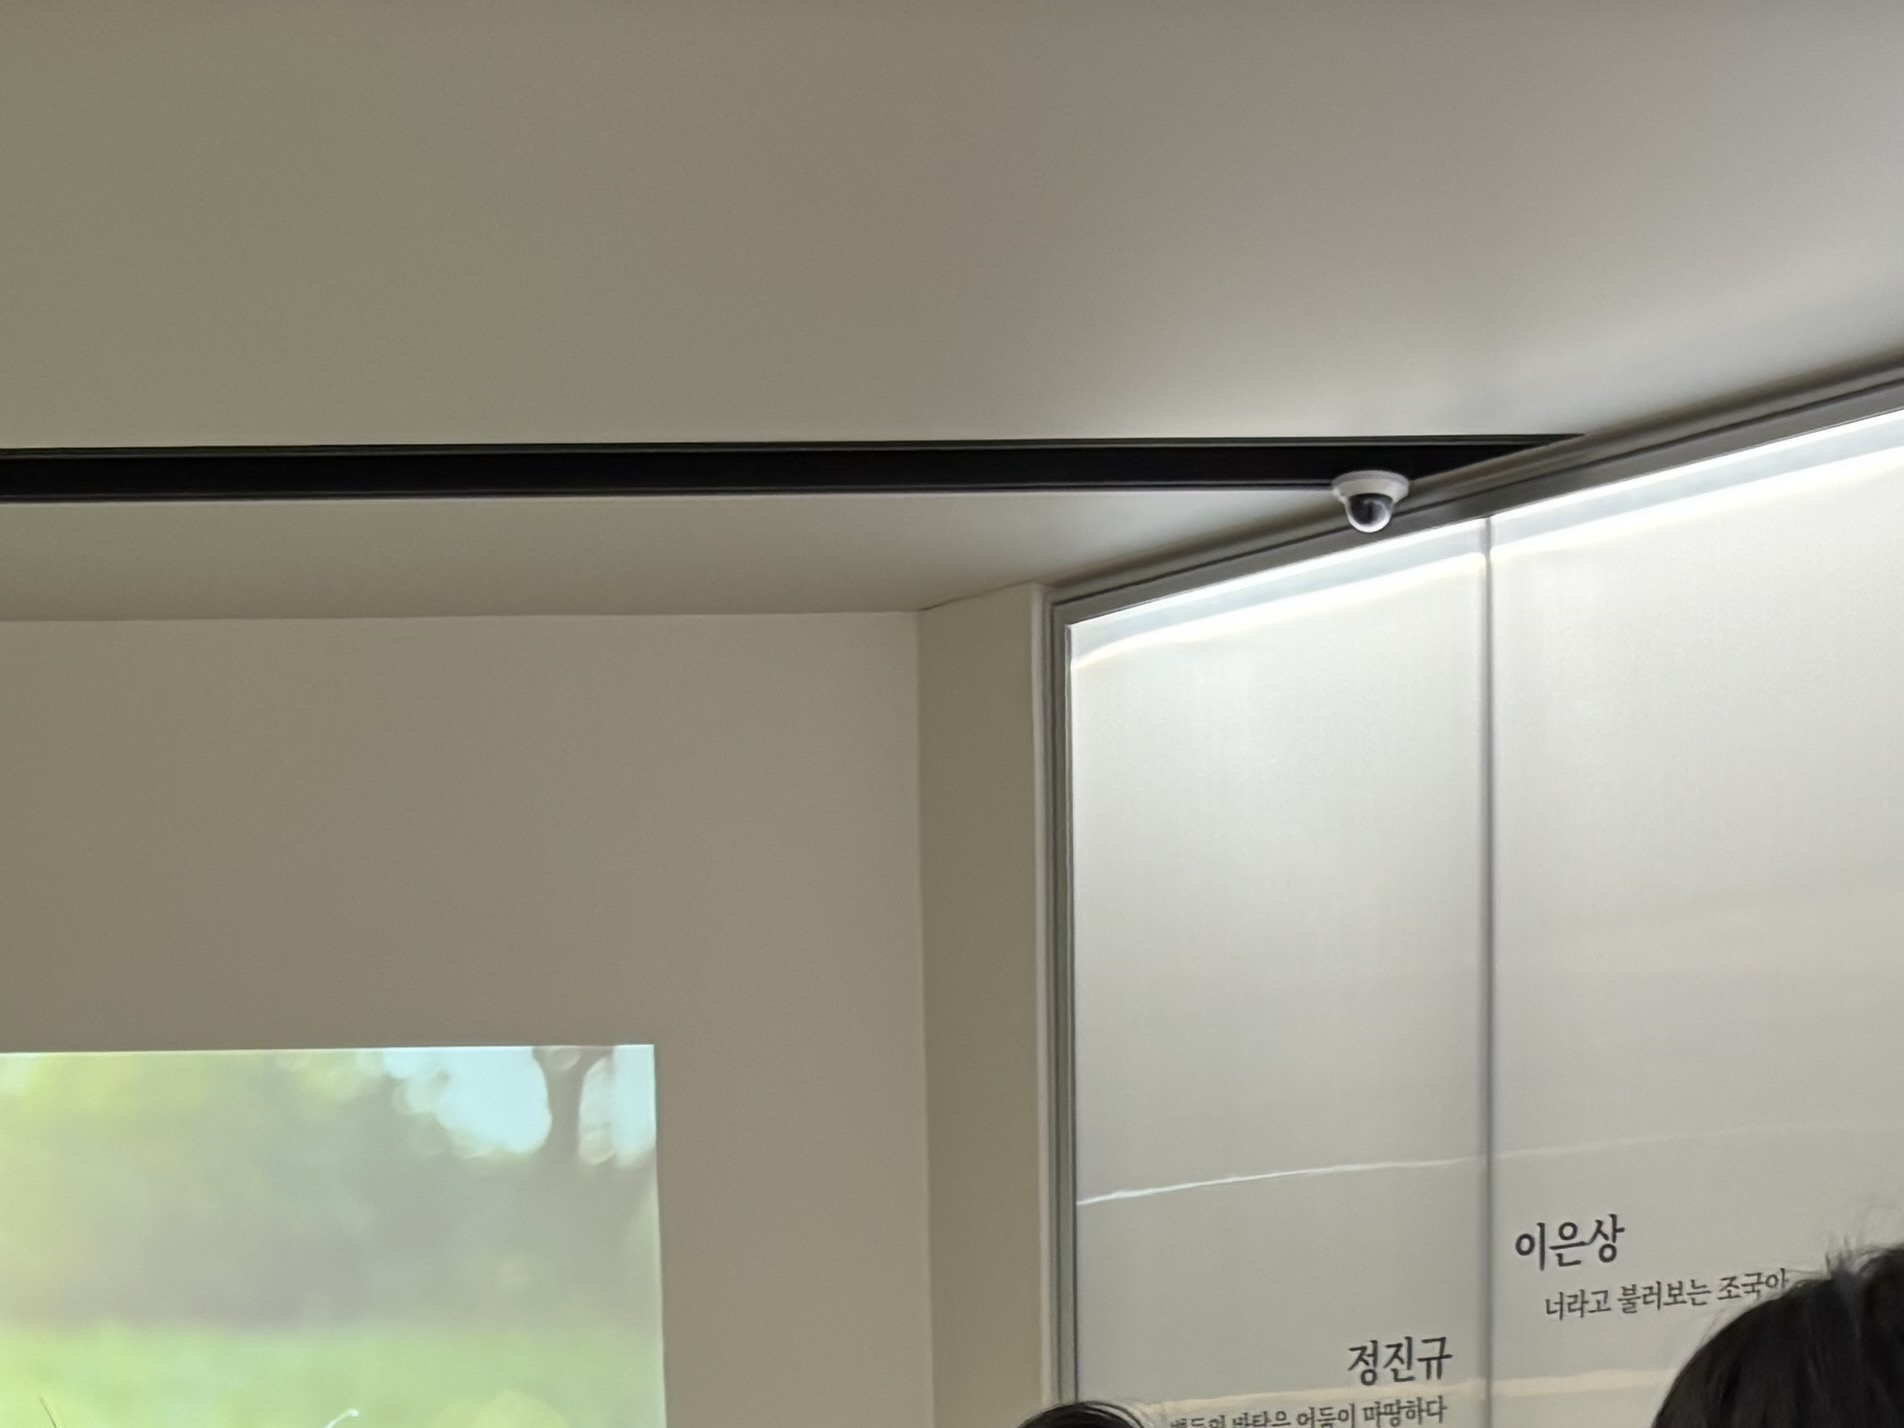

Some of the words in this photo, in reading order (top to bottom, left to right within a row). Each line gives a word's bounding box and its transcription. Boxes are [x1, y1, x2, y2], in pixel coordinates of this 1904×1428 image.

[1515, 1214, 1625, 1272] 이은상
[1545, 1289, 1612, 1321] 너라고
[1617, 1279, 1712, 1315] 불러보는
[1716, 1267, 1790, 1301] 조국아
[1348, 1335, 1454, 1387] 정진규
[1362, 1394, 1448, 1428] 마땅하다
